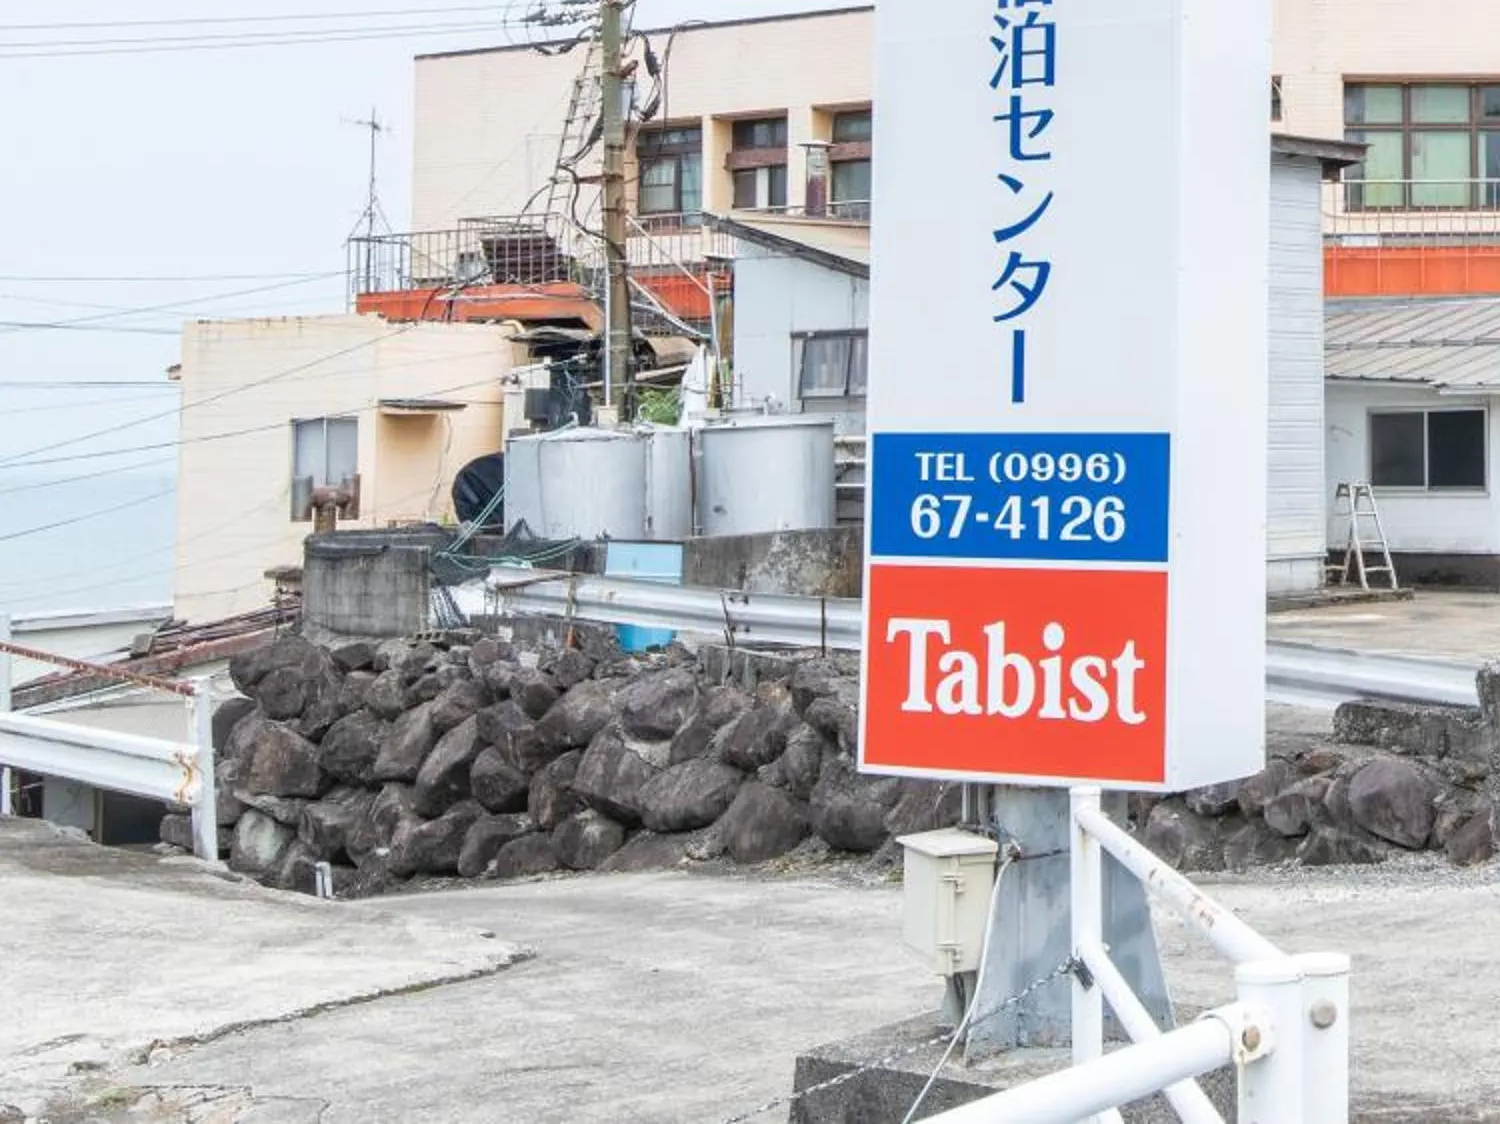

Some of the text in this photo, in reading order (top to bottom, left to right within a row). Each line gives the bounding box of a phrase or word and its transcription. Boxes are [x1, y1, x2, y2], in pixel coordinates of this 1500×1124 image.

[914, 452, 1127, 484] TEL (0996)
[910, 493, 1127, 543] 67-4126
[885, 616, 1148, 726] Tabist
